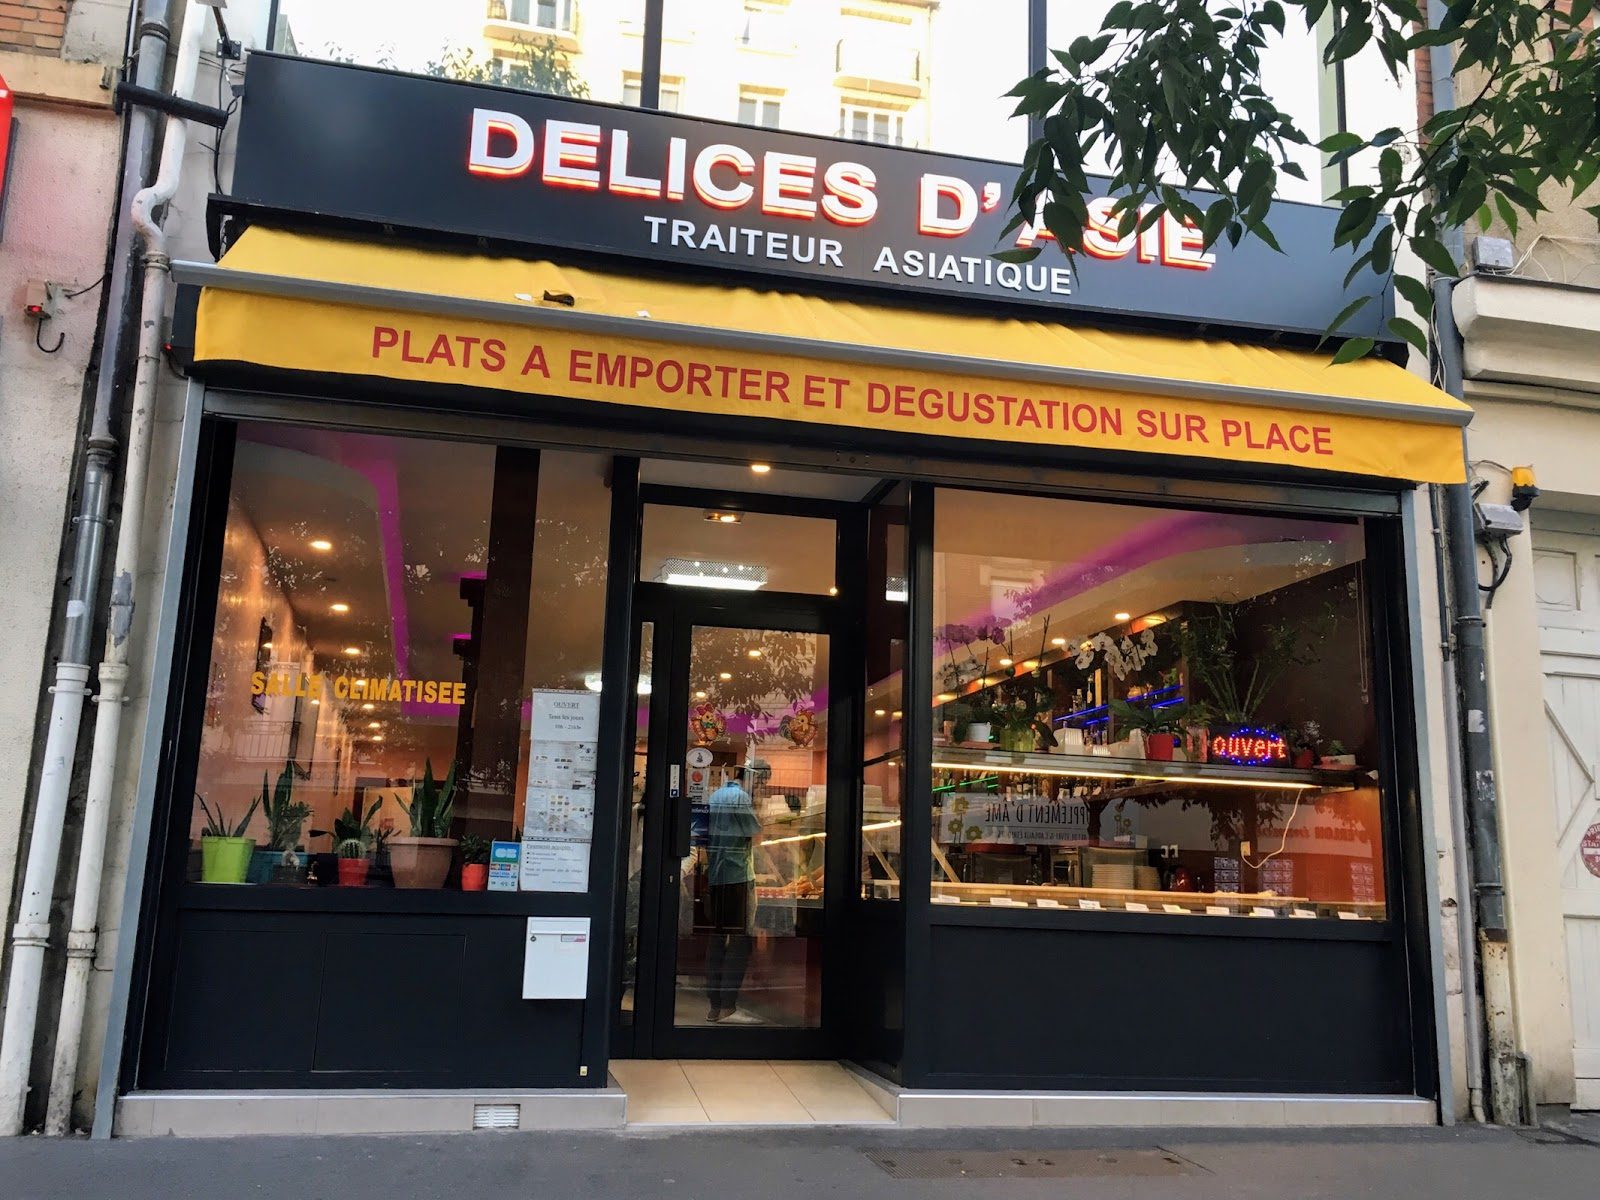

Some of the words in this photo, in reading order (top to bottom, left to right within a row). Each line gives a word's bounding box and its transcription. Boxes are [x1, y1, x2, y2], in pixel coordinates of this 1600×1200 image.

[468, 107, 878, 227] DELICES
[644, 215, 843, 268] TRAITEUR
[873, 246, 1073, 296] ASIATIQUE
[372, 326, 507, 373] PLATS
[521, 345, 551, 379] A
[569, 349, 791, 403] EMPORTER
[803, 375, 850, 409] ET
[867, 382, 1122, 436] DEGUSTATION
[1137, 409, 1209, 443] SUR
[1221, 419, 1334, 455] PLACE
[251, 671, 322, 699] SALLE
[334, 675, 467, 705] CLIMATISEE
[1212, 735, 1287, 759] ouvert
